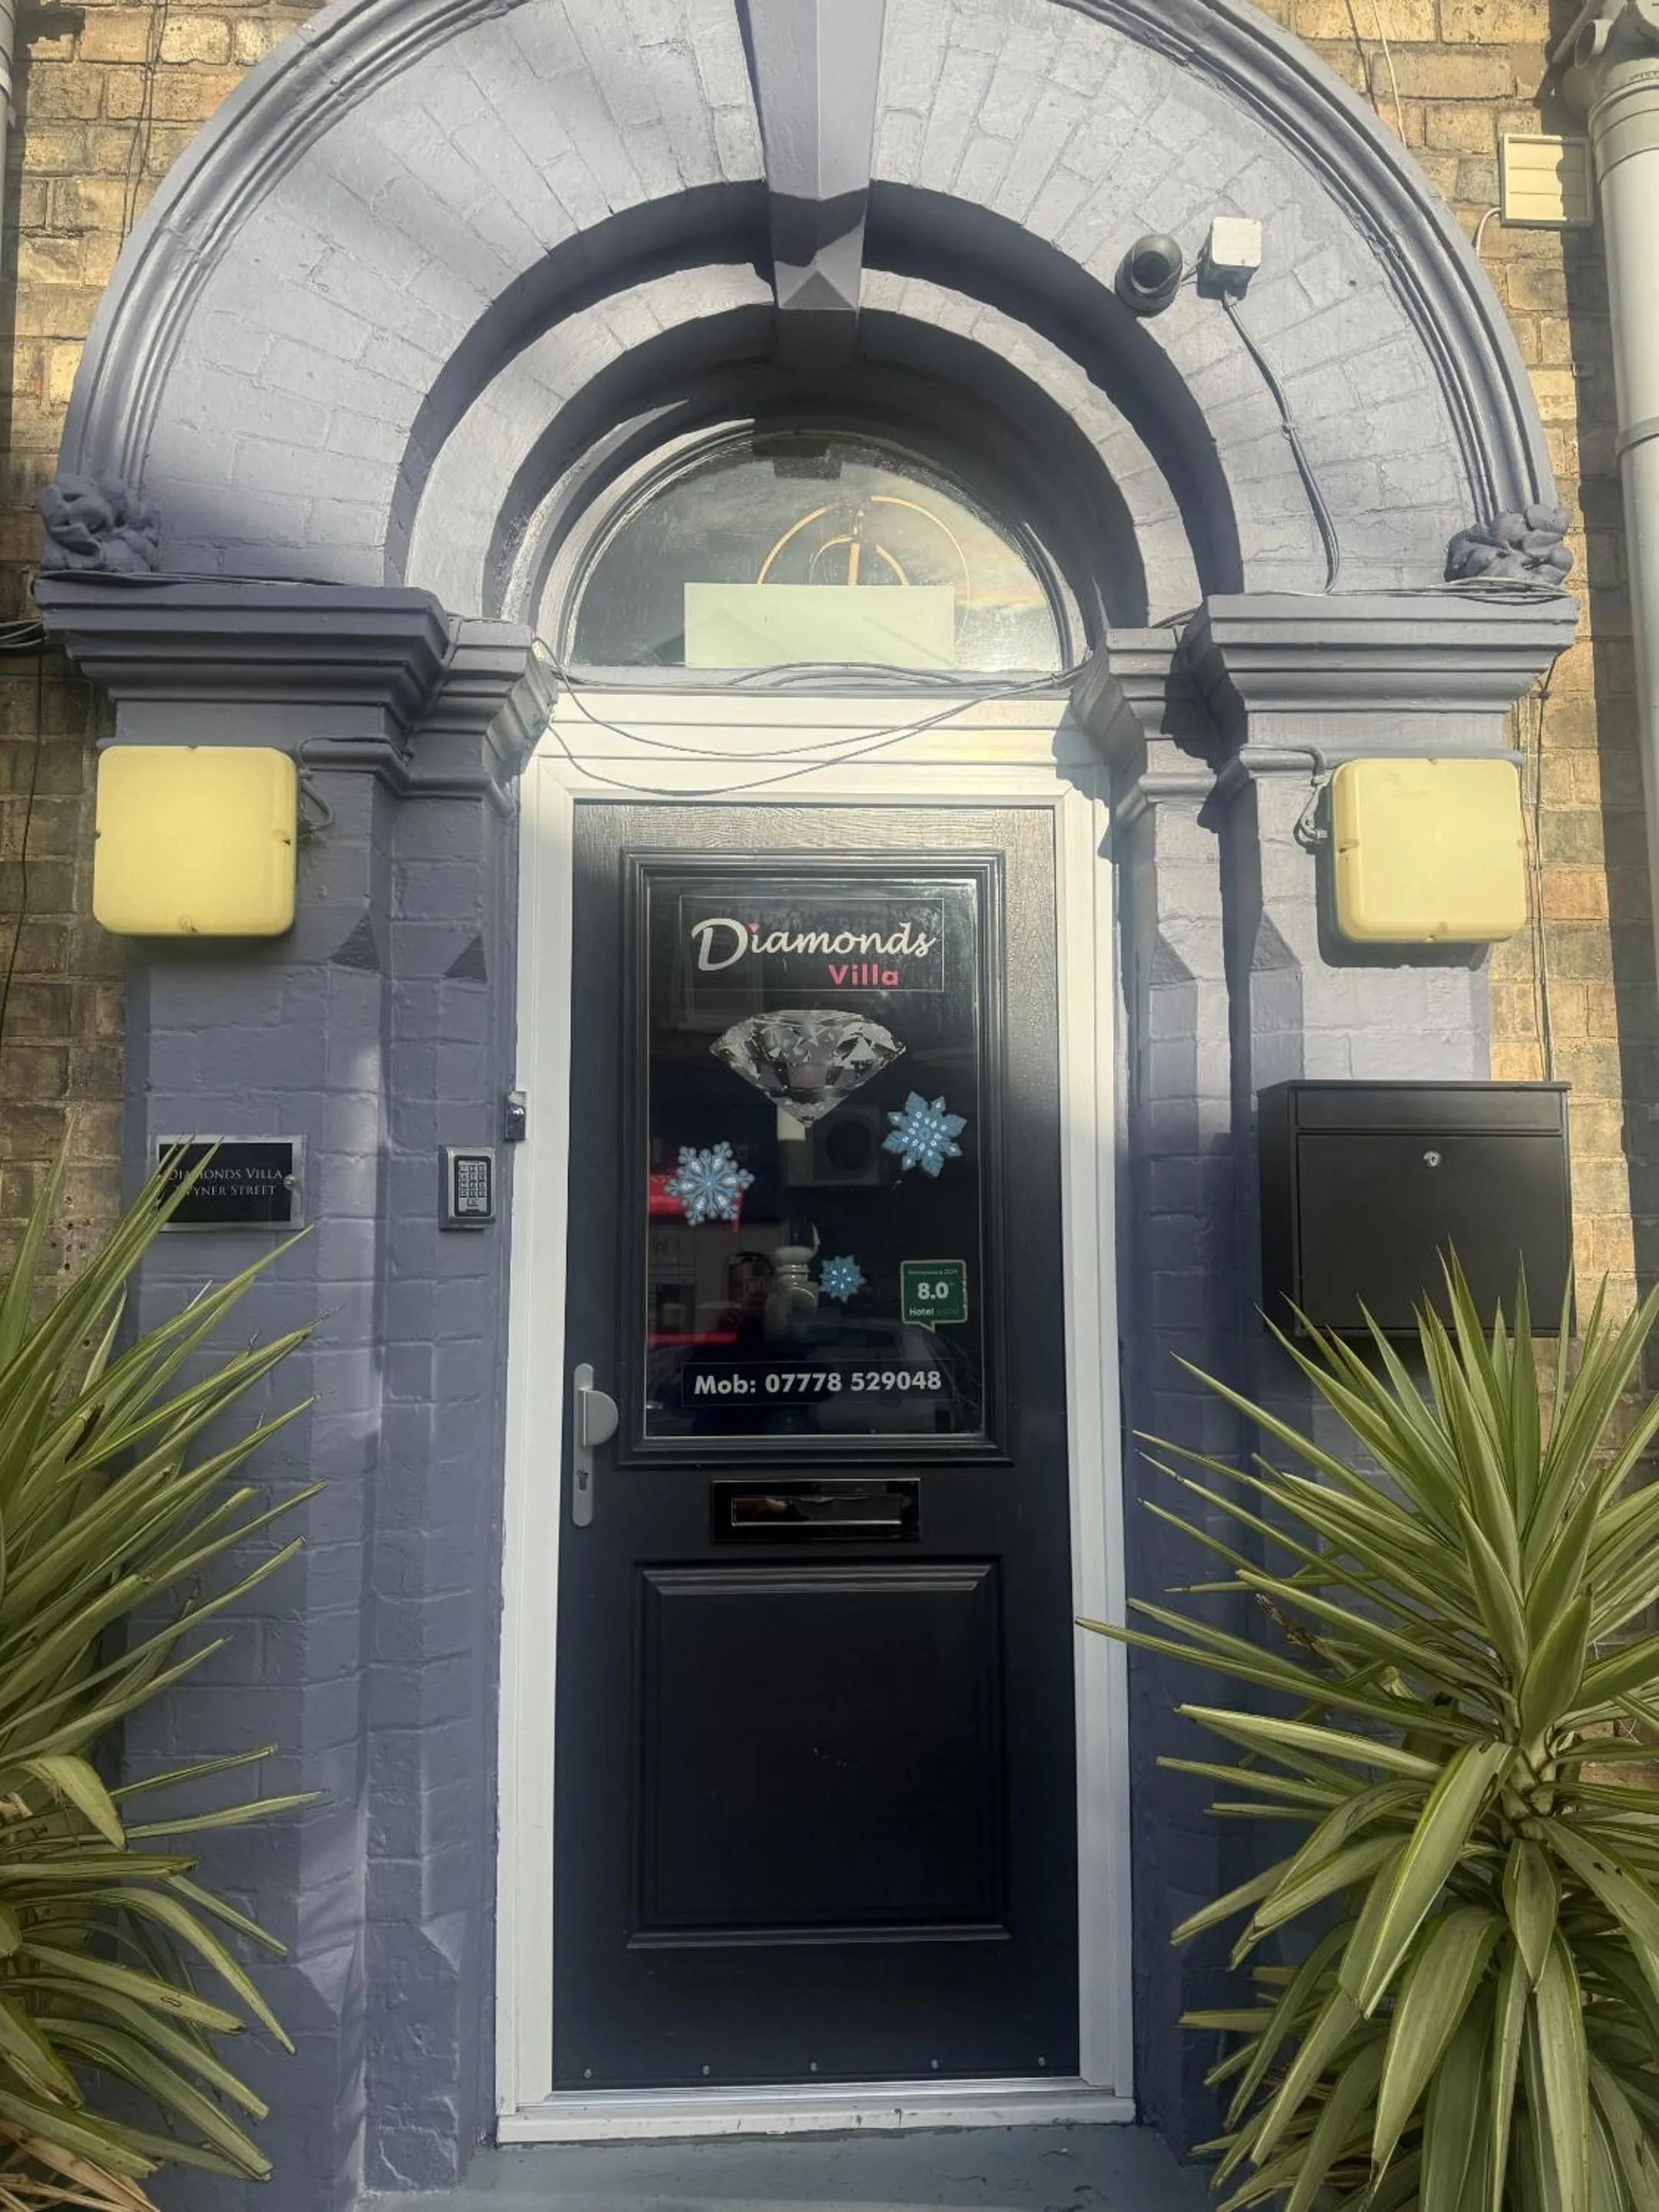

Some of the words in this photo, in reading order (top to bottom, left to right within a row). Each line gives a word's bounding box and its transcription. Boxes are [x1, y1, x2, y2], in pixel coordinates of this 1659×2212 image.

[691, 918, 937, 971] Diamonds
[828, 964, 900, 986] Villa
[167, 1169, 242, 1180] DIONDS
[246, 1167, 283, 1179] VILLA
[230, 1185, 277, 1195] STREET
[917, 1281, 949, 1300] 8.0
[909, 1307, 935, 1316] Hotel
[694, 1374, 756, 1395] Mob:
[765, 1371, 843, 1393] 07778
[850, 1370, 942, 1391] 529048
